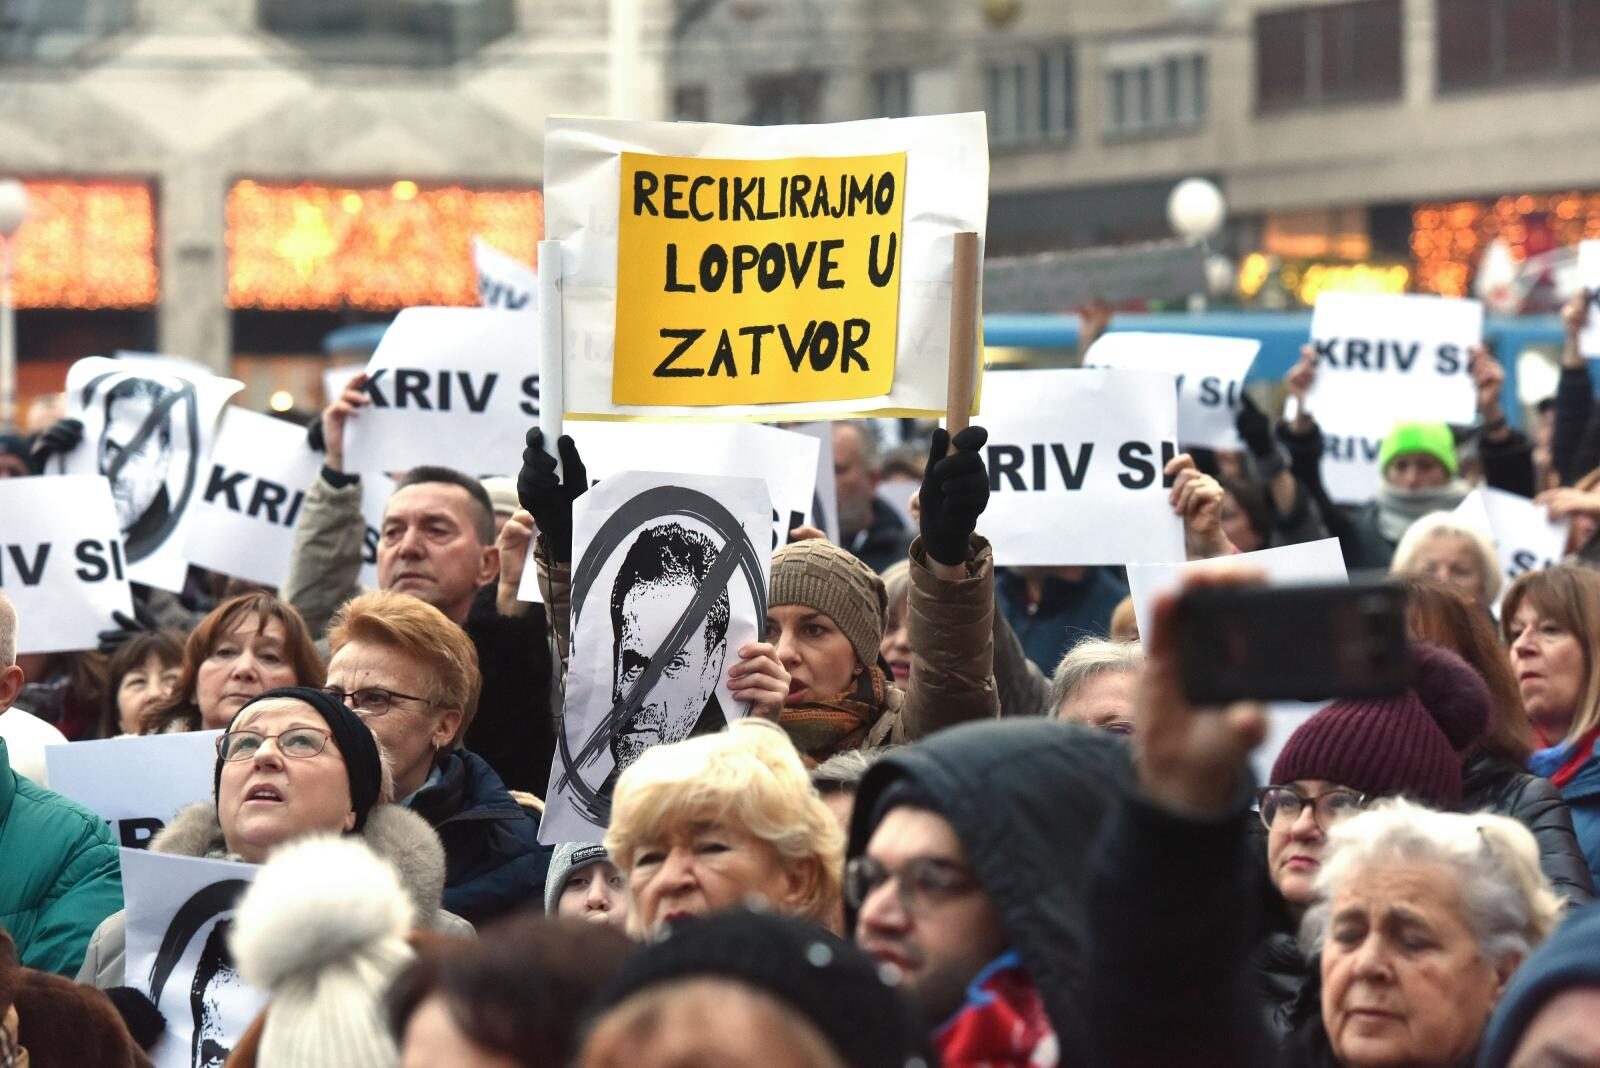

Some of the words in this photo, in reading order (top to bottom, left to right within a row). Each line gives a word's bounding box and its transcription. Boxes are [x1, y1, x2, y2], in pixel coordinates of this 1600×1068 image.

[634, 171, 894, 221] RECIKLIRAJMO
[664, 240, 844, 293] LOPOVE
[868, 232, 896, 287] U
[653, 319, 870, 377] ZATVOR
[1312, 336, 1420, 372] KRIV
[360, 367, 498, 413] KRIV
[74, 538, 125, 584] SI
